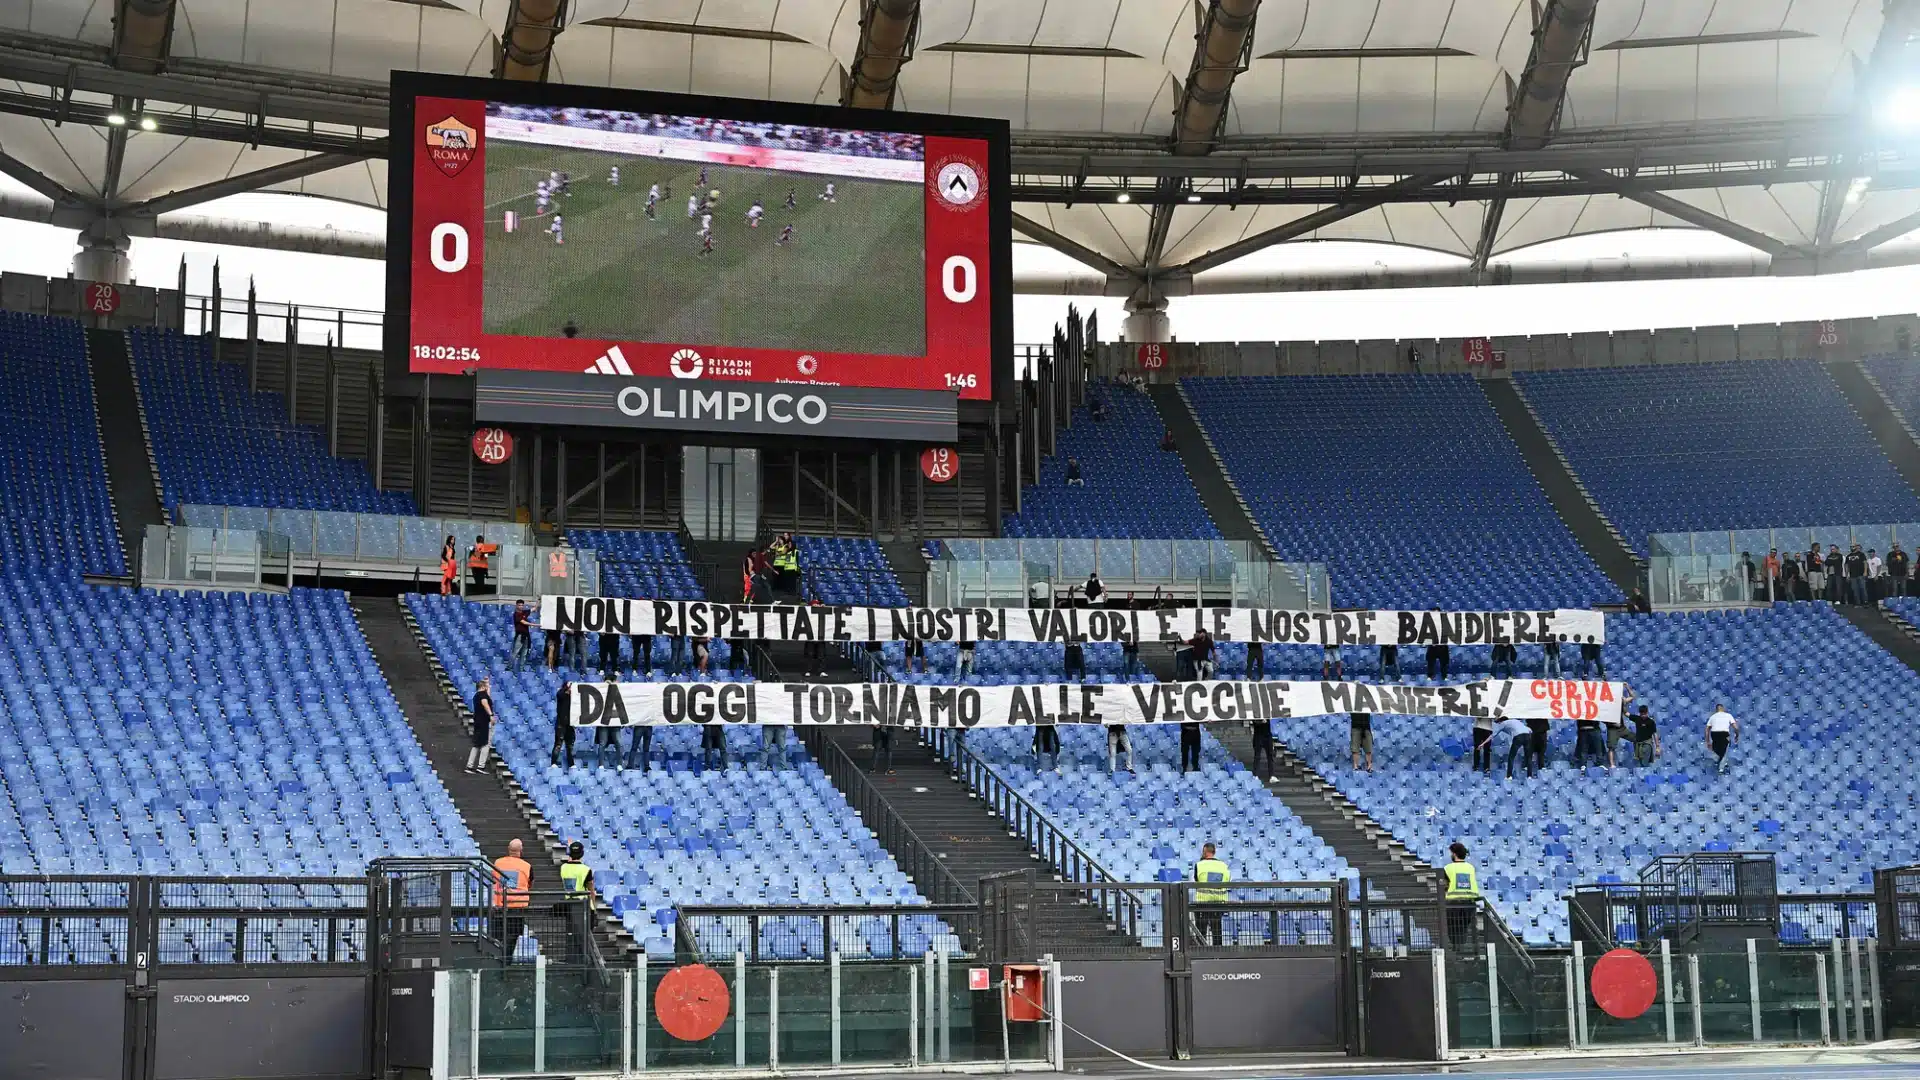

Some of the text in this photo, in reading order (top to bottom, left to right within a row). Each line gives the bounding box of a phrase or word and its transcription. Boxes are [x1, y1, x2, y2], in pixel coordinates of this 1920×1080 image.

[433, 150, 469, 161] ROMA
[430, 222, 469, 272] 0
[942, 255, 977, 303] 0
[95, 285, 112, 298] 20
[93, 298, 112, 311] AS
[1820, 321, 1835, 332] 18
[1469, 339, 1482, 350] 18
[1819, 333, 1837, 344] AD
[413, 344, 481, 361] 18:02:54
[1146, 344, 1160, 356] 19
[1468, 350, 1484, 362] AS
[708, 358, 752, 368] RIYADH
[1144, 356, 1162, 368] AD
[708, 367, 752, 376] SEASON
[944, 373, 977, 388] 1:46
[617, 386, 828, 425] OLIMPICO
[484, 427, 504, 444] 20
[481, 443, 506, 460] AD
[931, 447, 949, 462] 19
[930, 462, 951, 478] AS
[555, 597, 1595, 645] NON RISPETTATE I NOSTRI VALORI E LE NOSTRE BANDIERE...
[1530, 679, 1614, 702] CURVA
[577, 681, 1513, 726] DA OGGI TORNIAMO ALLE VECCHIE MANIERE!
[1550, 700, 1599, 720] SUD
[1174, 938, 1179, 950] 3
[138, 953, 145, 967] 2
[1202, 973, 1226, 981] STADIO
[173, 994, 250, 1003] STADIO OLIMPICO
